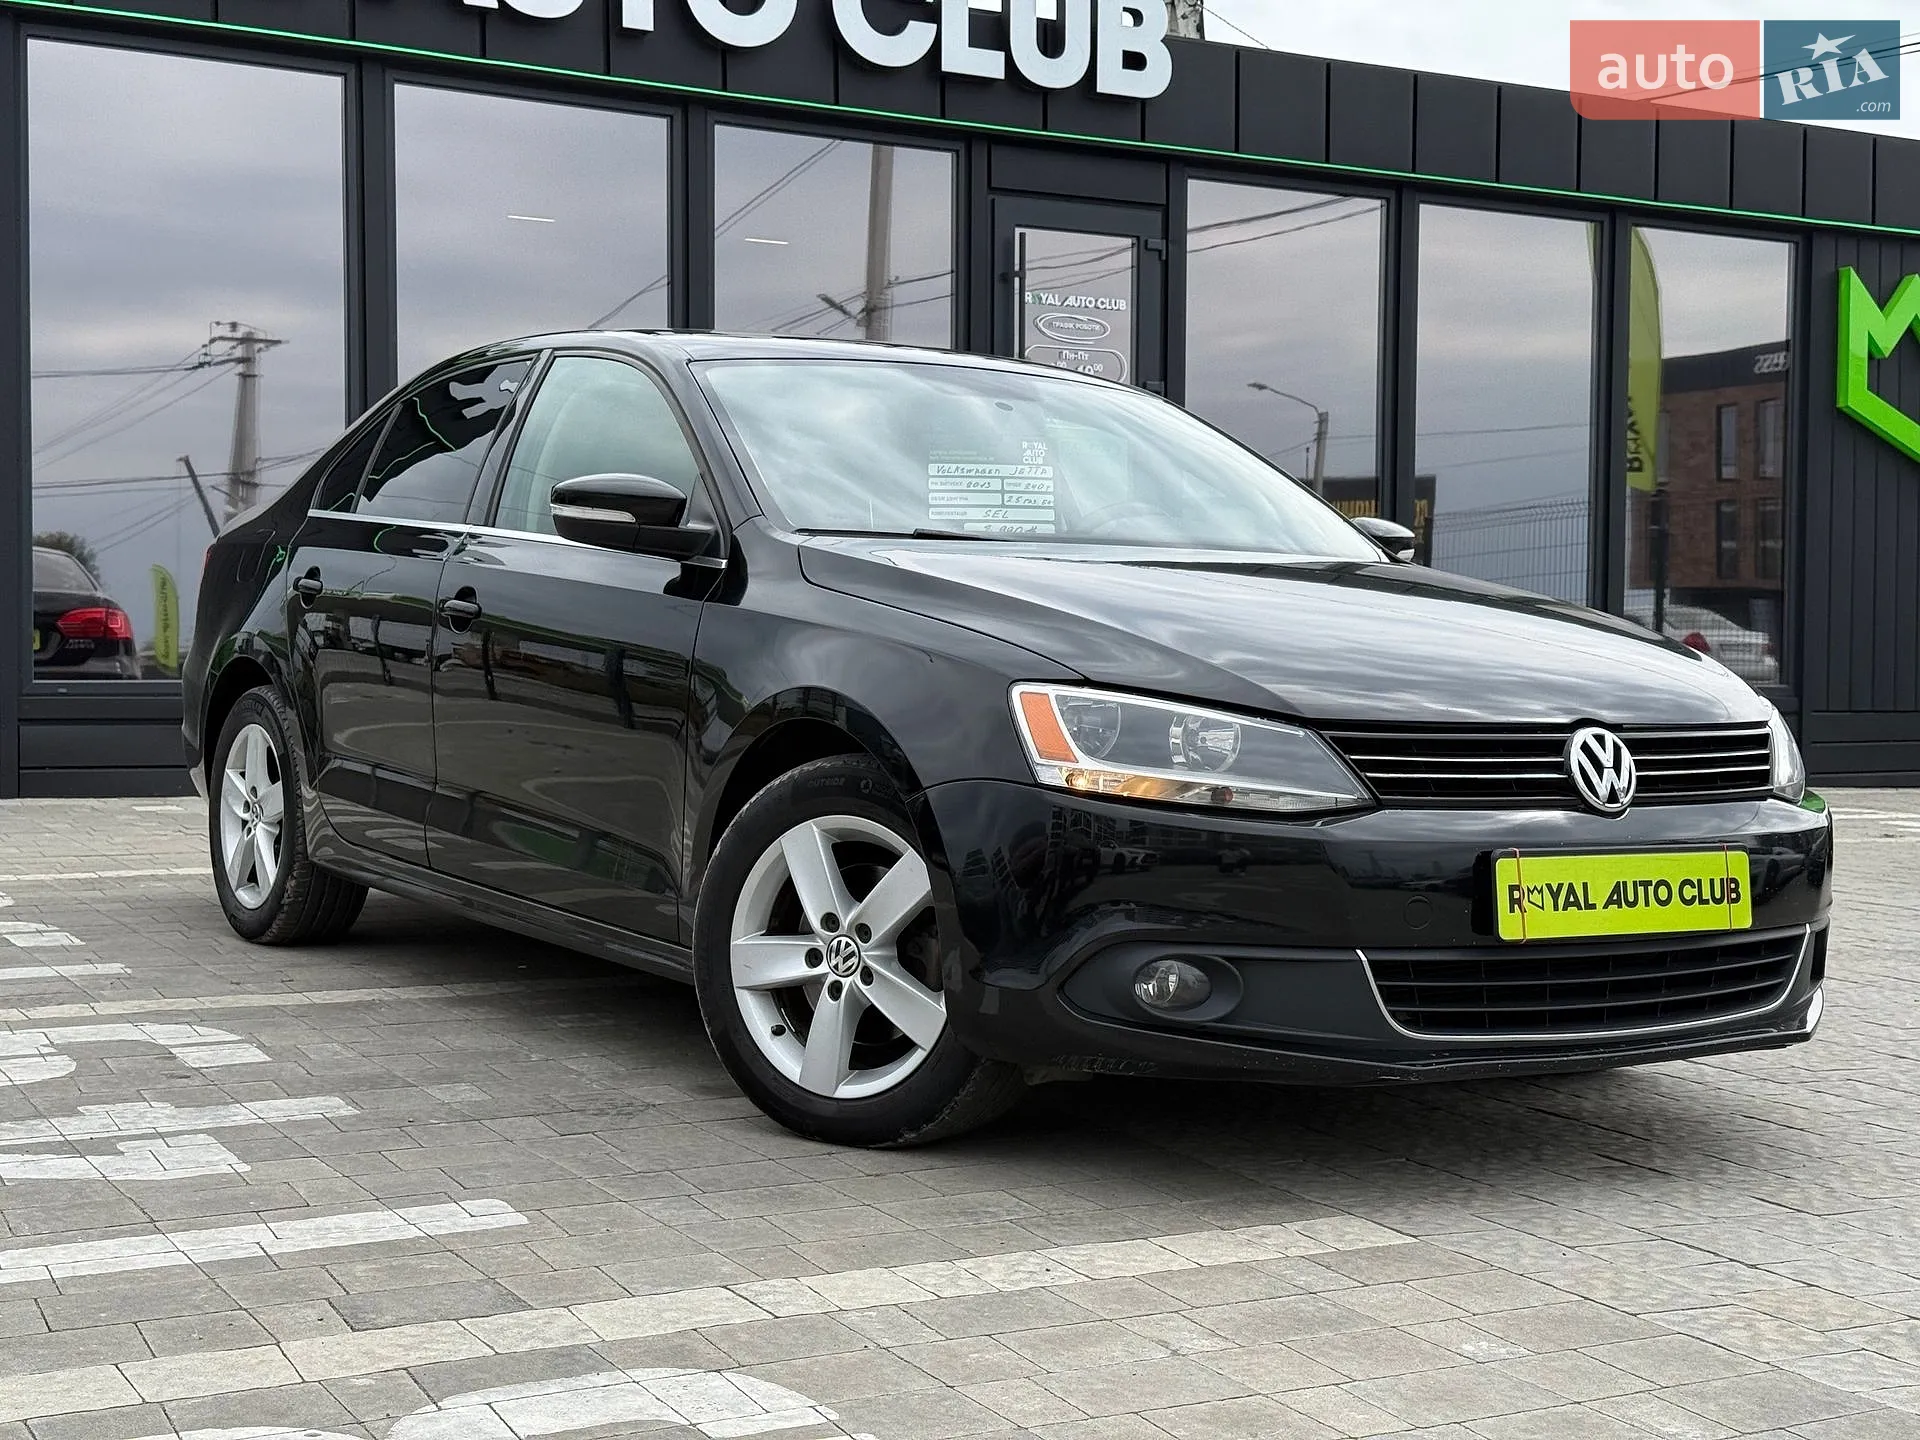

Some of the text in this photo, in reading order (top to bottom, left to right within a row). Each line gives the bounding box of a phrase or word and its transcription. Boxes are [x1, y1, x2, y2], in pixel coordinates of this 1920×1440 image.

[832, 0, 1173, 99] CLUB
[1063, 296, 1095, 308] AUTO
[1097, 299, 1127, 310] CLUB
[1022, 441, 1048, 450] RYAL
[1022, 449, 1045, 457] AUTO
[982, 509, 1009, 519] SEL
[1602, 878, 1673, 910] AUTO
[1677, 877, 1742, 906] CLUB
